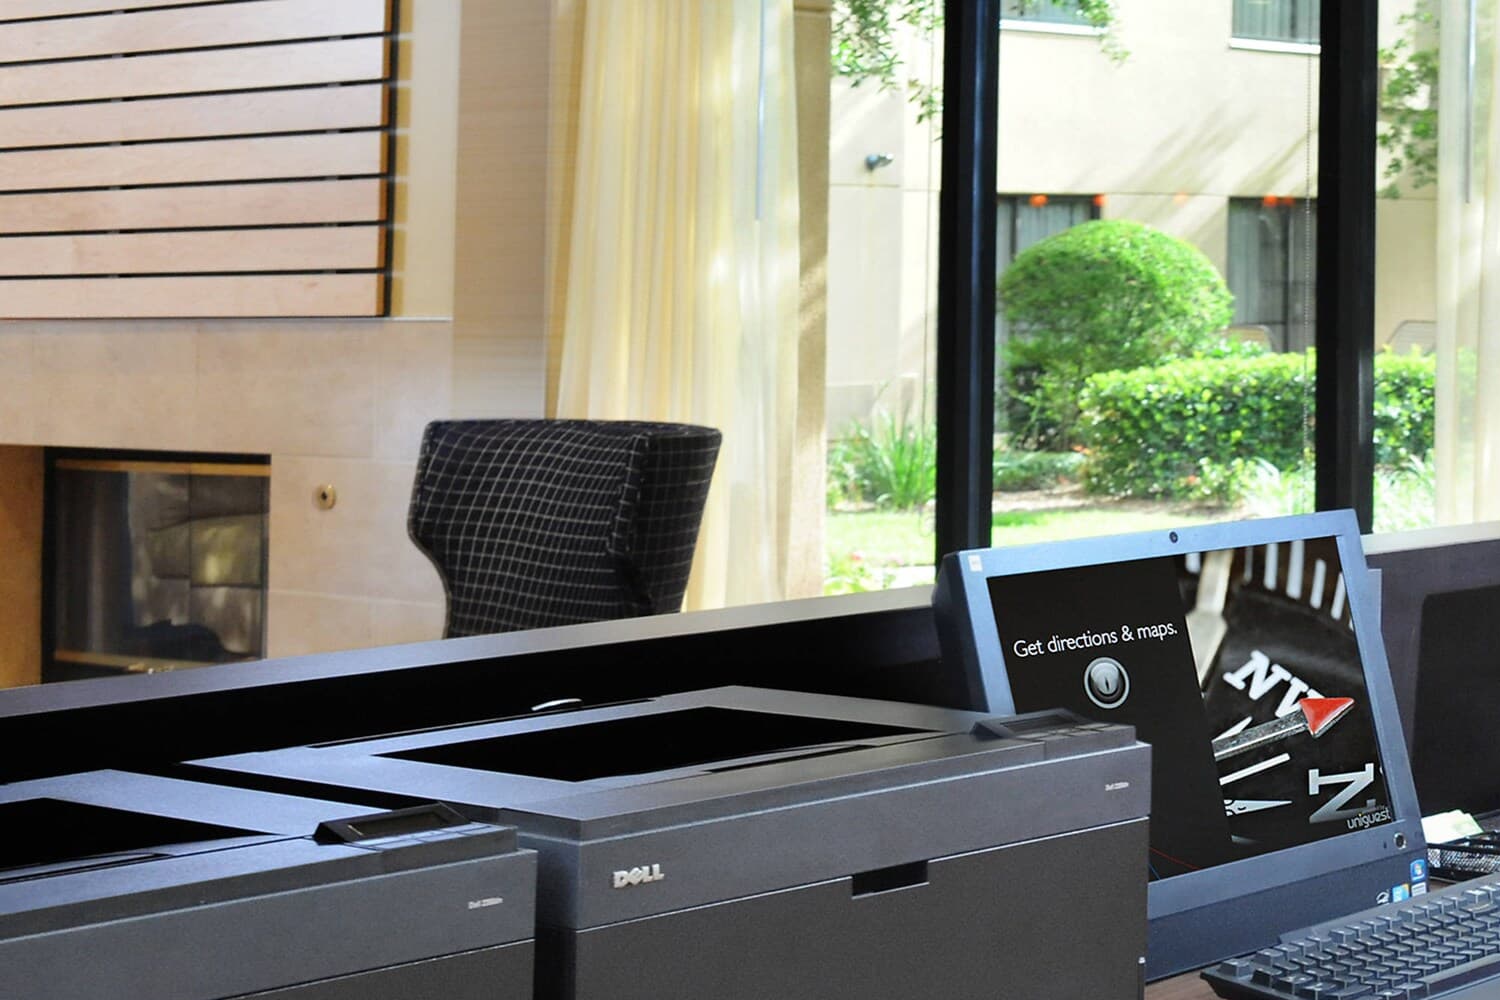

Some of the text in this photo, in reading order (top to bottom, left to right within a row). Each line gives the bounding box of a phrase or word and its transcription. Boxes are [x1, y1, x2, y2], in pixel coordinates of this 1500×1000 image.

[1013, 622, 1178, 657] Get directions & maps.
[1347, 807, 1391, 829] uniguest
[613, 863, 665, 889] DELL
